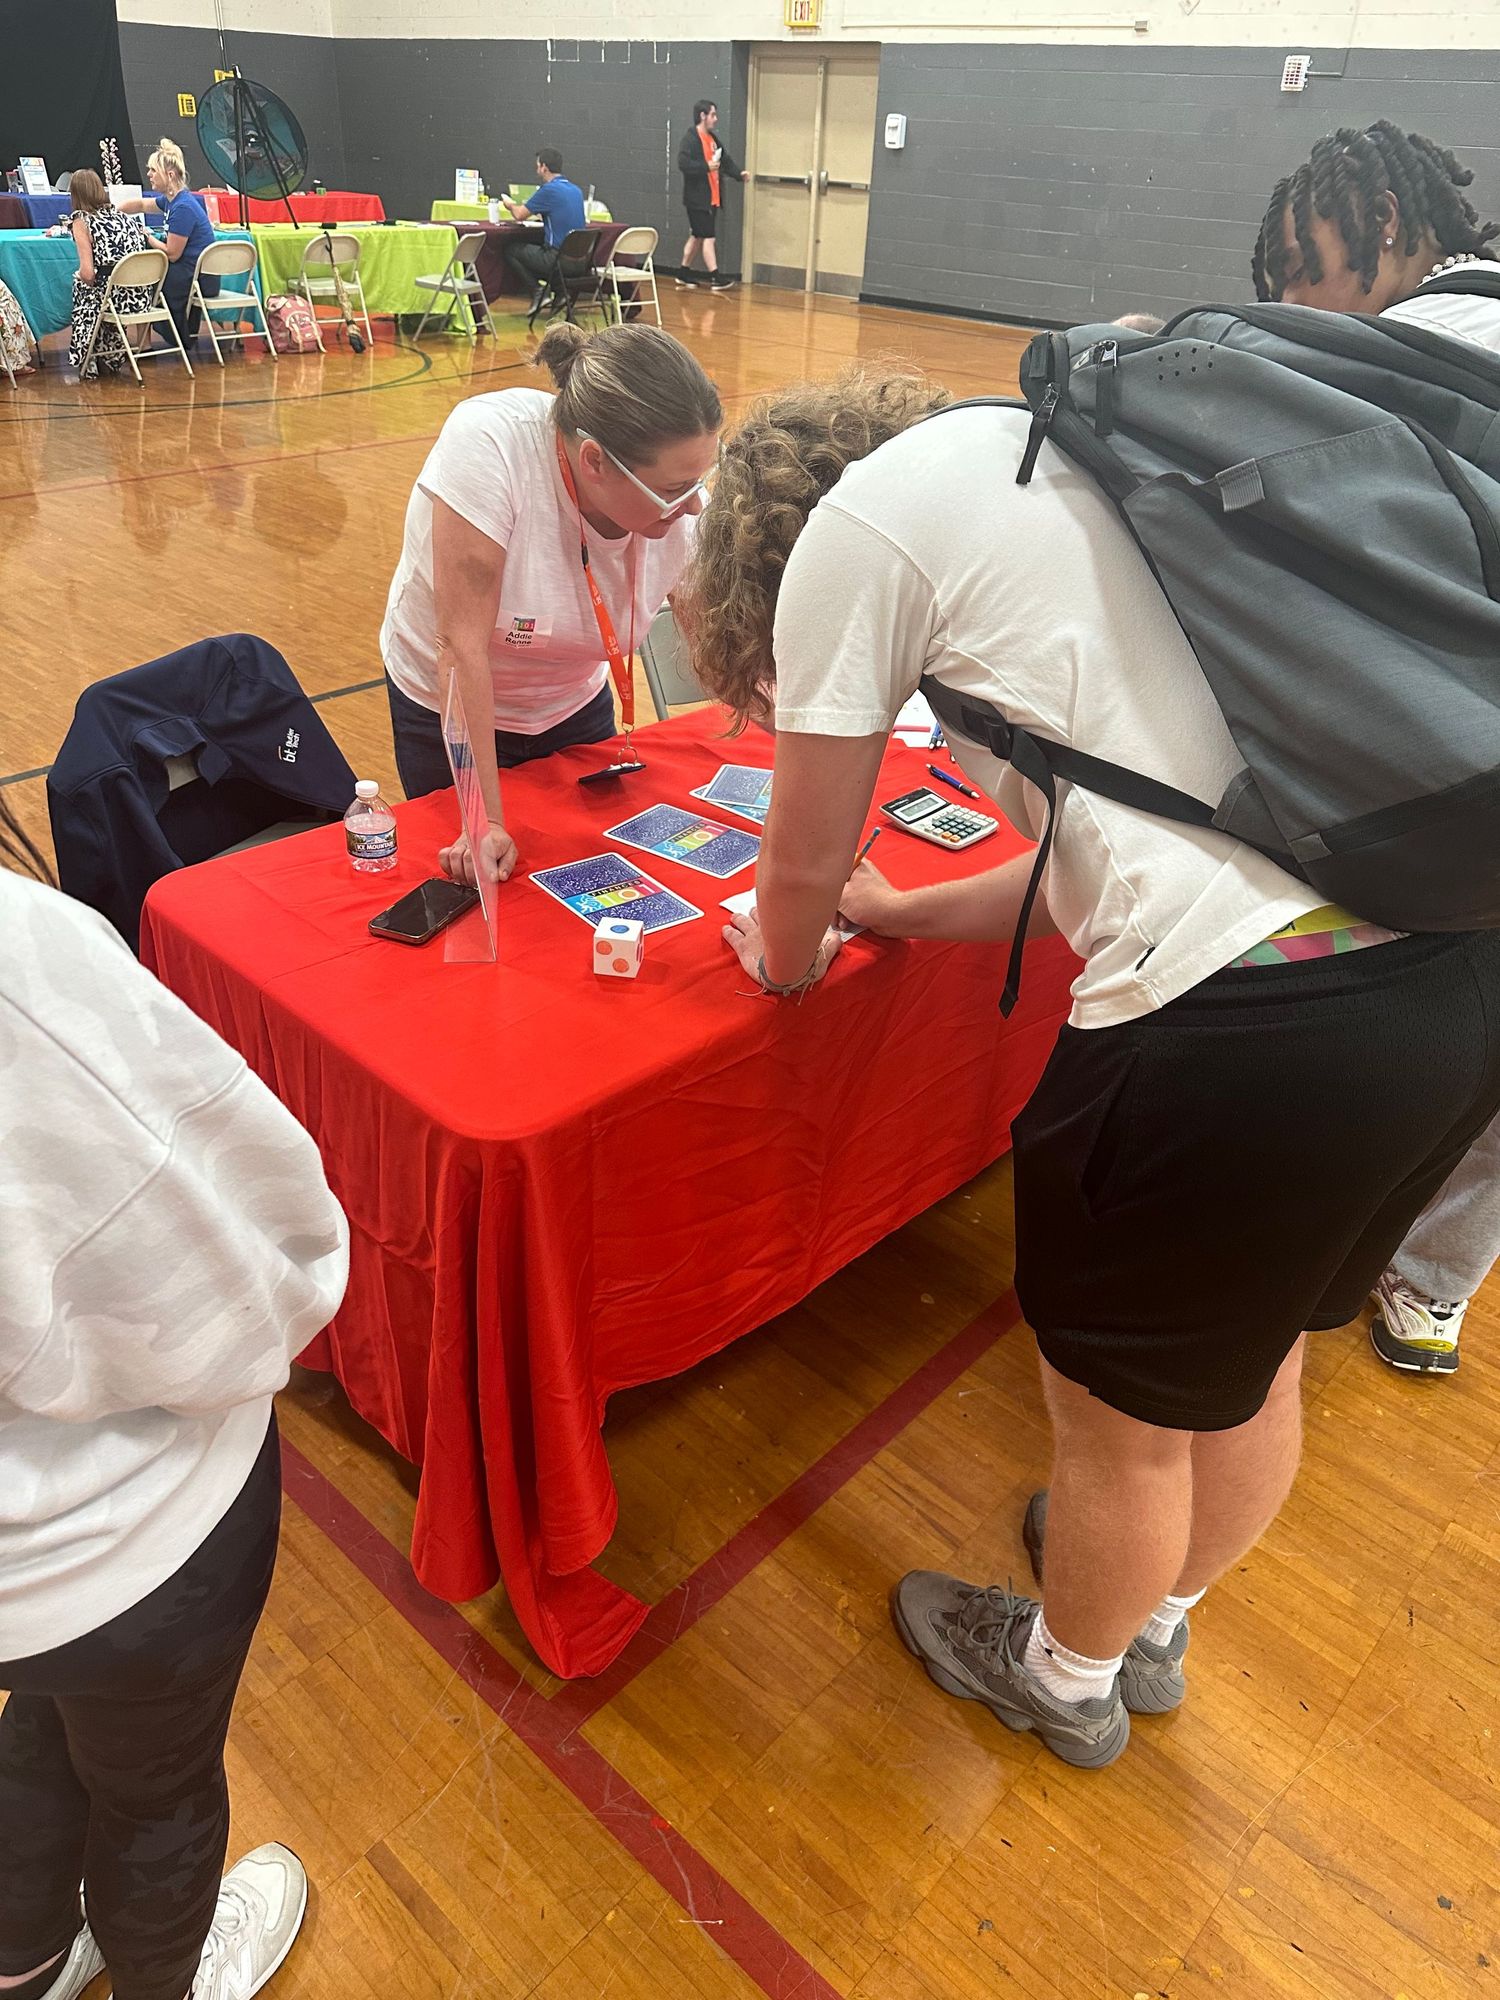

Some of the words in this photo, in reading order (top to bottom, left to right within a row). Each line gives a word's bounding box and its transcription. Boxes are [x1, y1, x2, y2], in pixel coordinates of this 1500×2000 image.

[794, 1, 810, 21] EXIT
[507, 631, 533, 640] Addie
[602, 884, 656, 905] 101
